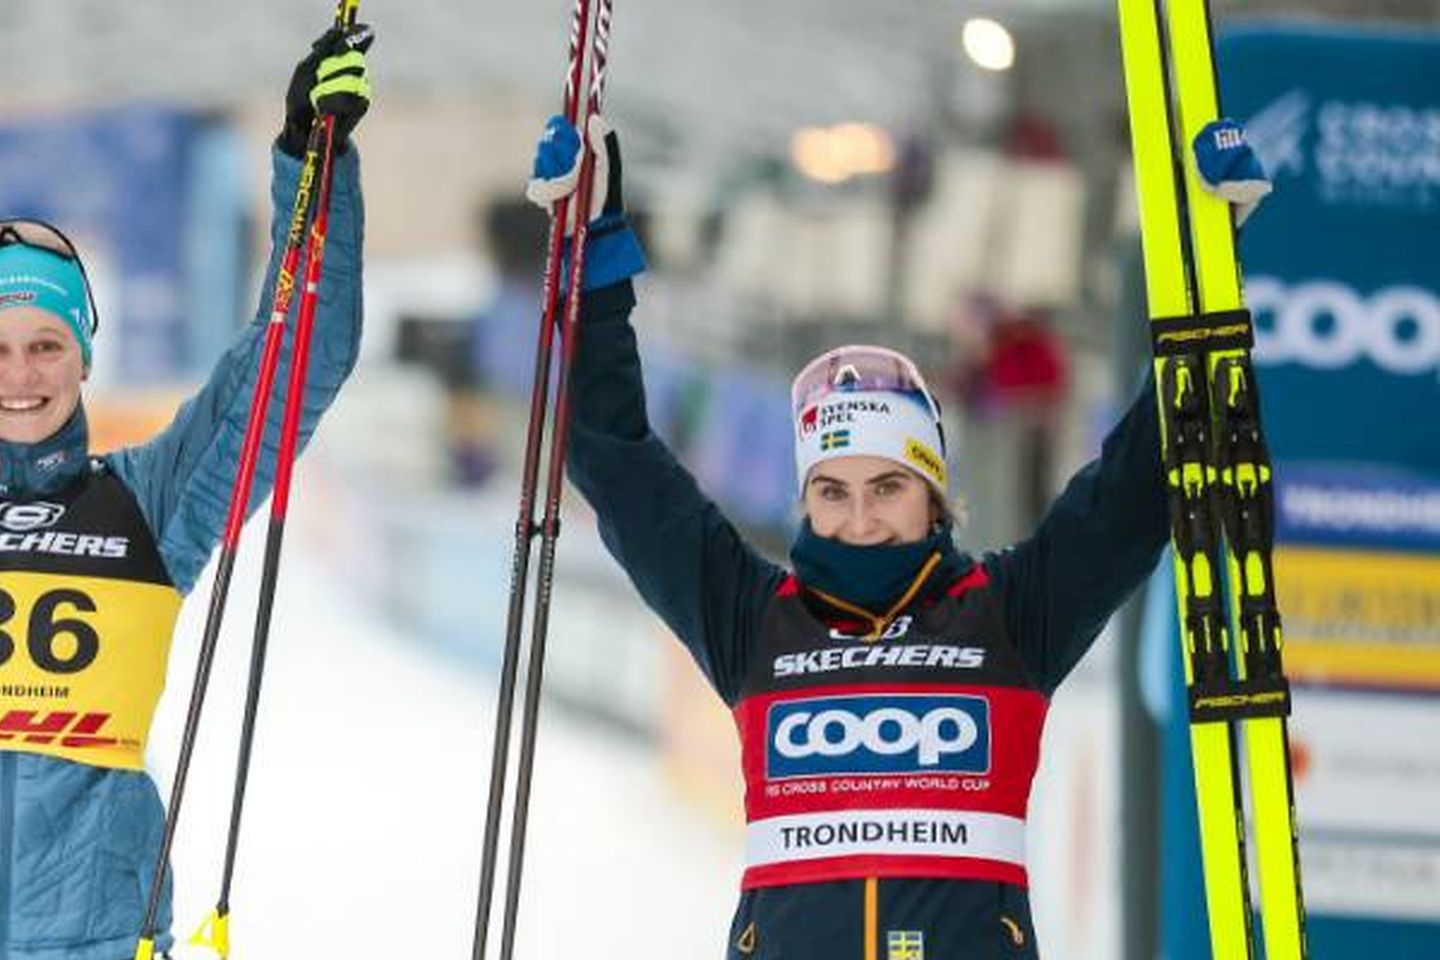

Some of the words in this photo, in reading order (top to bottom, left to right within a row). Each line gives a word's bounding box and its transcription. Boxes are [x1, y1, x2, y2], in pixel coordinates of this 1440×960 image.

[820, 412, 855, 428] SPEL
[773, 645, 987, 677] SKECHERS
[1194, 691, 1286, 709] FISCHER
[774, 707, 978, 766] coop
[782, 782, 827, 795] CROSS
[831, 779, 901, 793] COUNTRY
[905, 778, 959, 790] WORLD
[780, 821, 969, 850] TRONDHEIM
